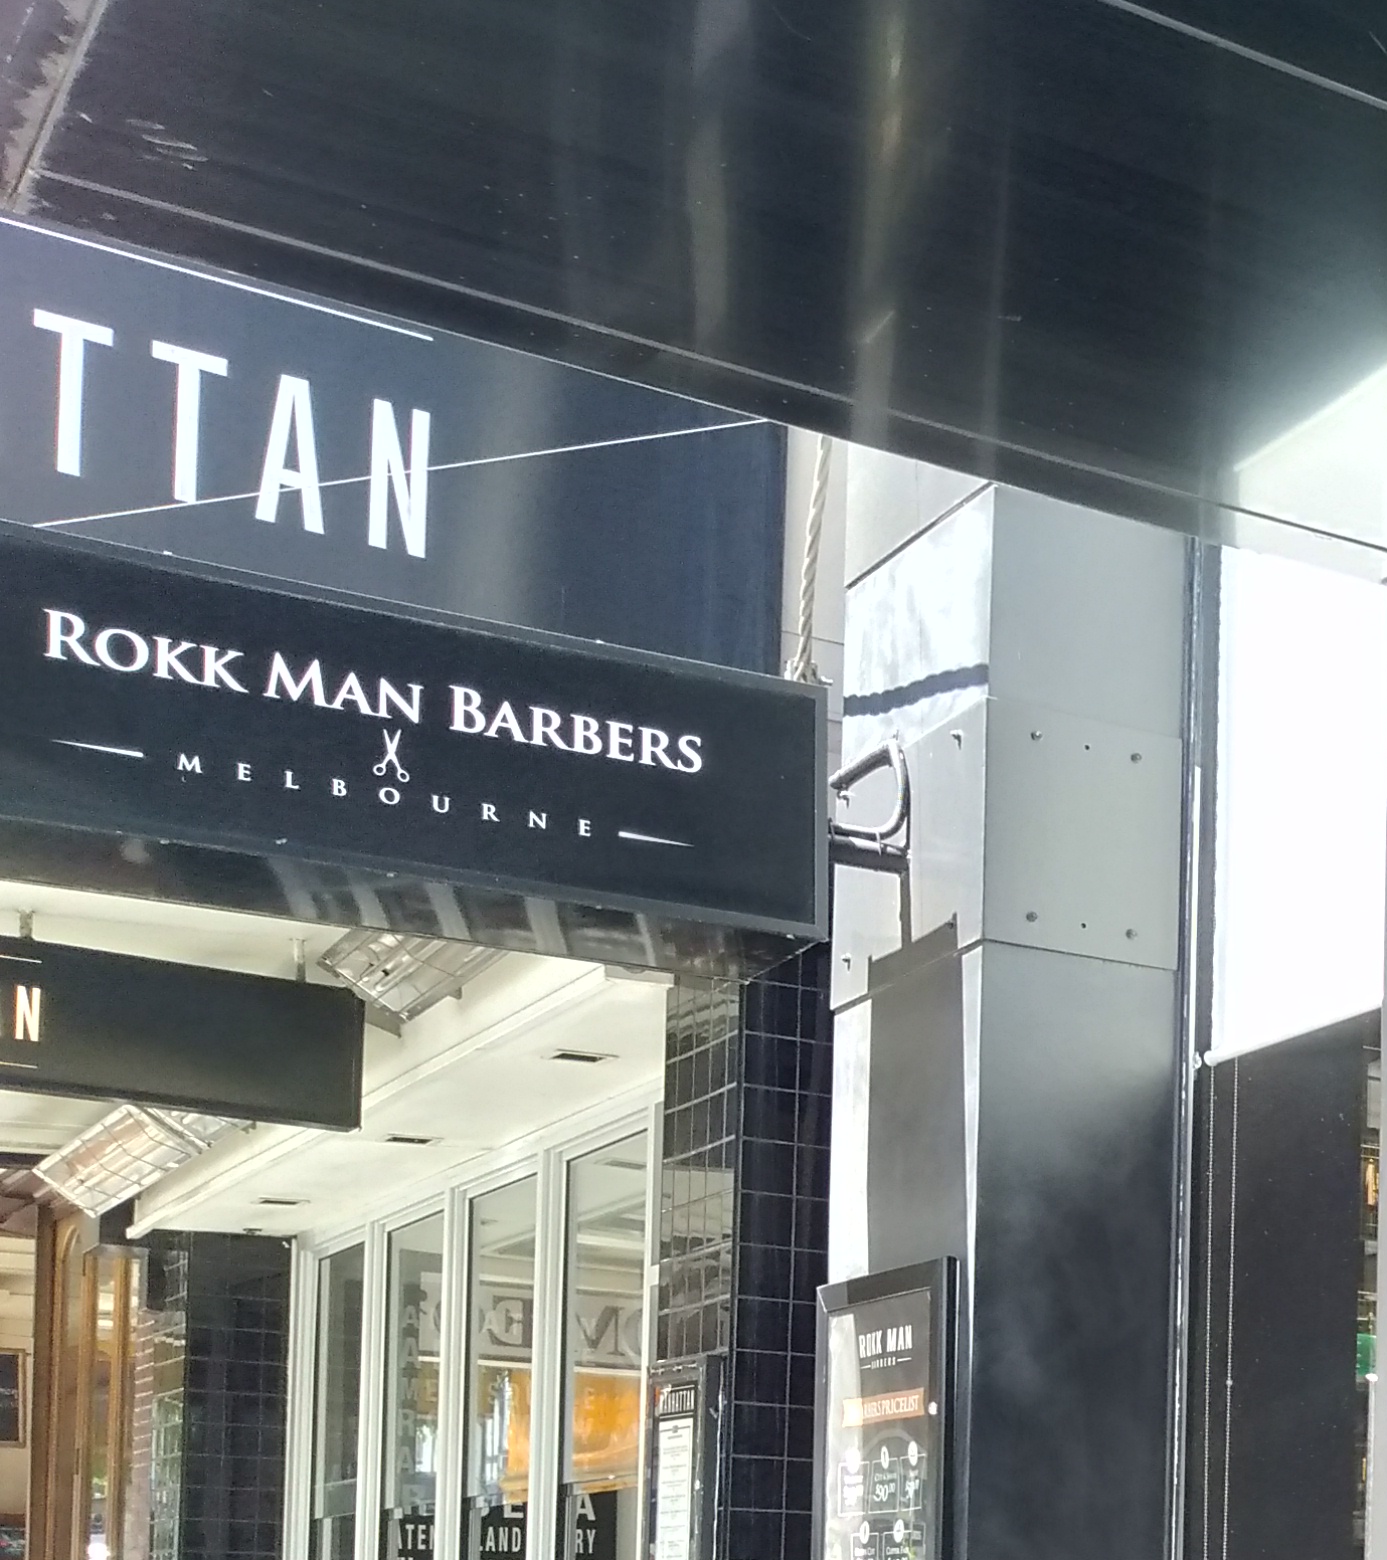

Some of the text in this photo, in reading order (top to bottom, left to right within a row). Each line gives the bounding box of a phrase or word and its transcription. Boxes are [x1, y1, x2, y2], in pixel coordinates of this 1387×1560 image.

[43, 608, 702, 773] ROKK MAN BARBERS
[177, 754, 591, 837] MELBOURNE
[886, 1325, 912, 1352] MAN
